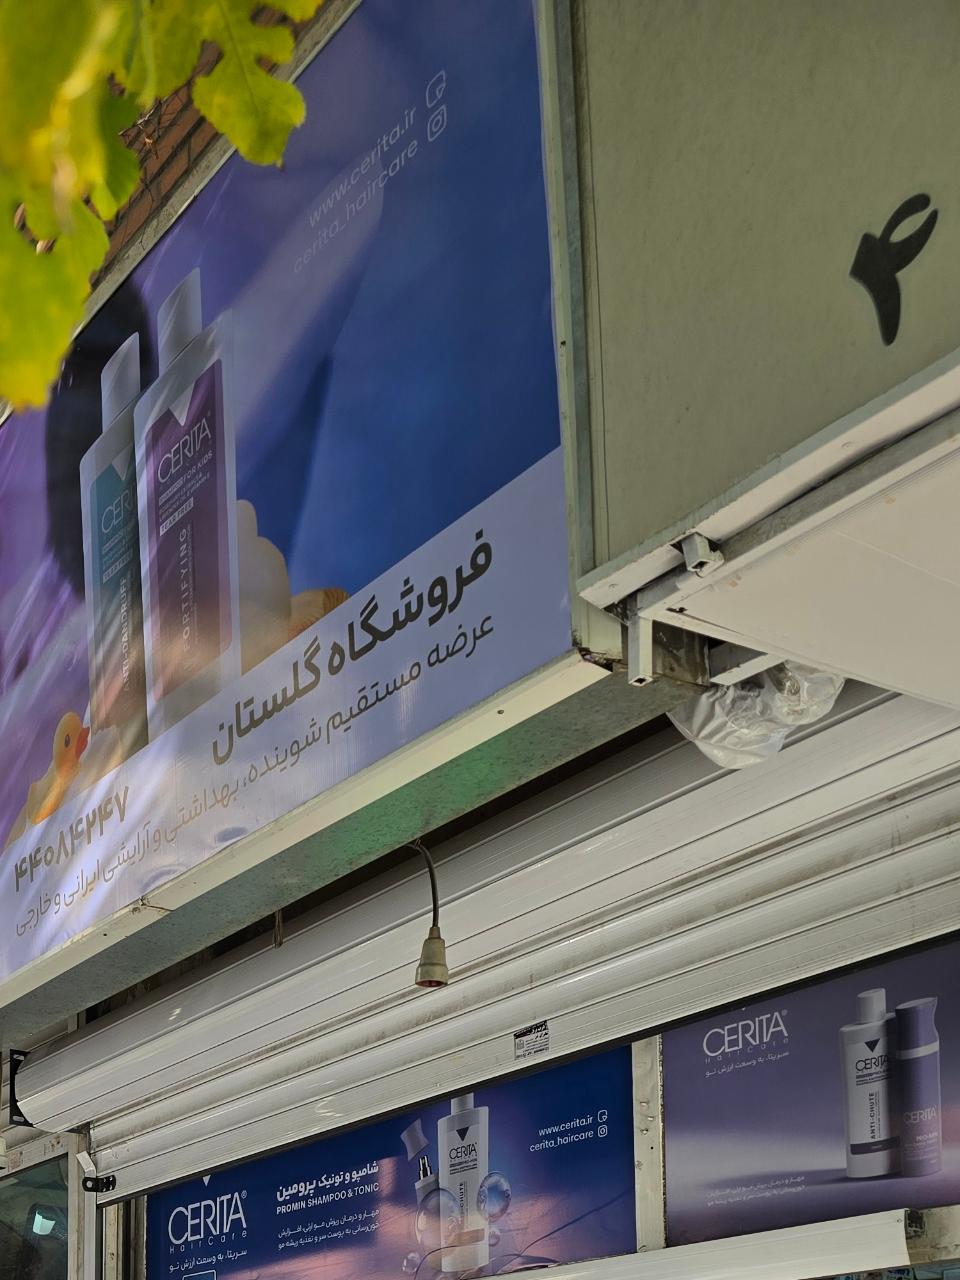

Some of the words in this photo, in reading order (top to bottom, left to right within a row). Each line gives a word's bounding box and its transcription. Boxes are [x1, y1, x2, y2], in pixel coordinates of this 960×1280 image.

[309, 107, 417, 227] www.cerita.ir
[294, 140, 418, 273] cerita_haircare
[157, 416, 213, 483] CERITA
[179, 527, 191, 652] FORTIFYING
[327, 528, 494, 678] فروشگاه
[426, 614, 495, 669] عرضه
[212, 636, 322, 767] گلستان
[325, 661, 422, 747] مستقیم
[164, 772, 239, 846] بهداشتی
[102, 818, 152, 880] آرایشی
[703, 1012, 788, 1057] CERITA
[529, 1128, 594, 1152] cerita_haircare
[538, 1114, 593, 1137] www.cerita.ir
[276, 1178, 318, 1202] پرومین
[276, 1200, 307, 1216] PROMIN
[307, 1191, 346, 1208] SHAMPOO
[354, 1182, 380, 1197] TONIC
[317, 1171, 344, 1189] تونیک
[351, 1161, 380, 1186] شامپو
[167, 1191, 247, 1246] CERITA
